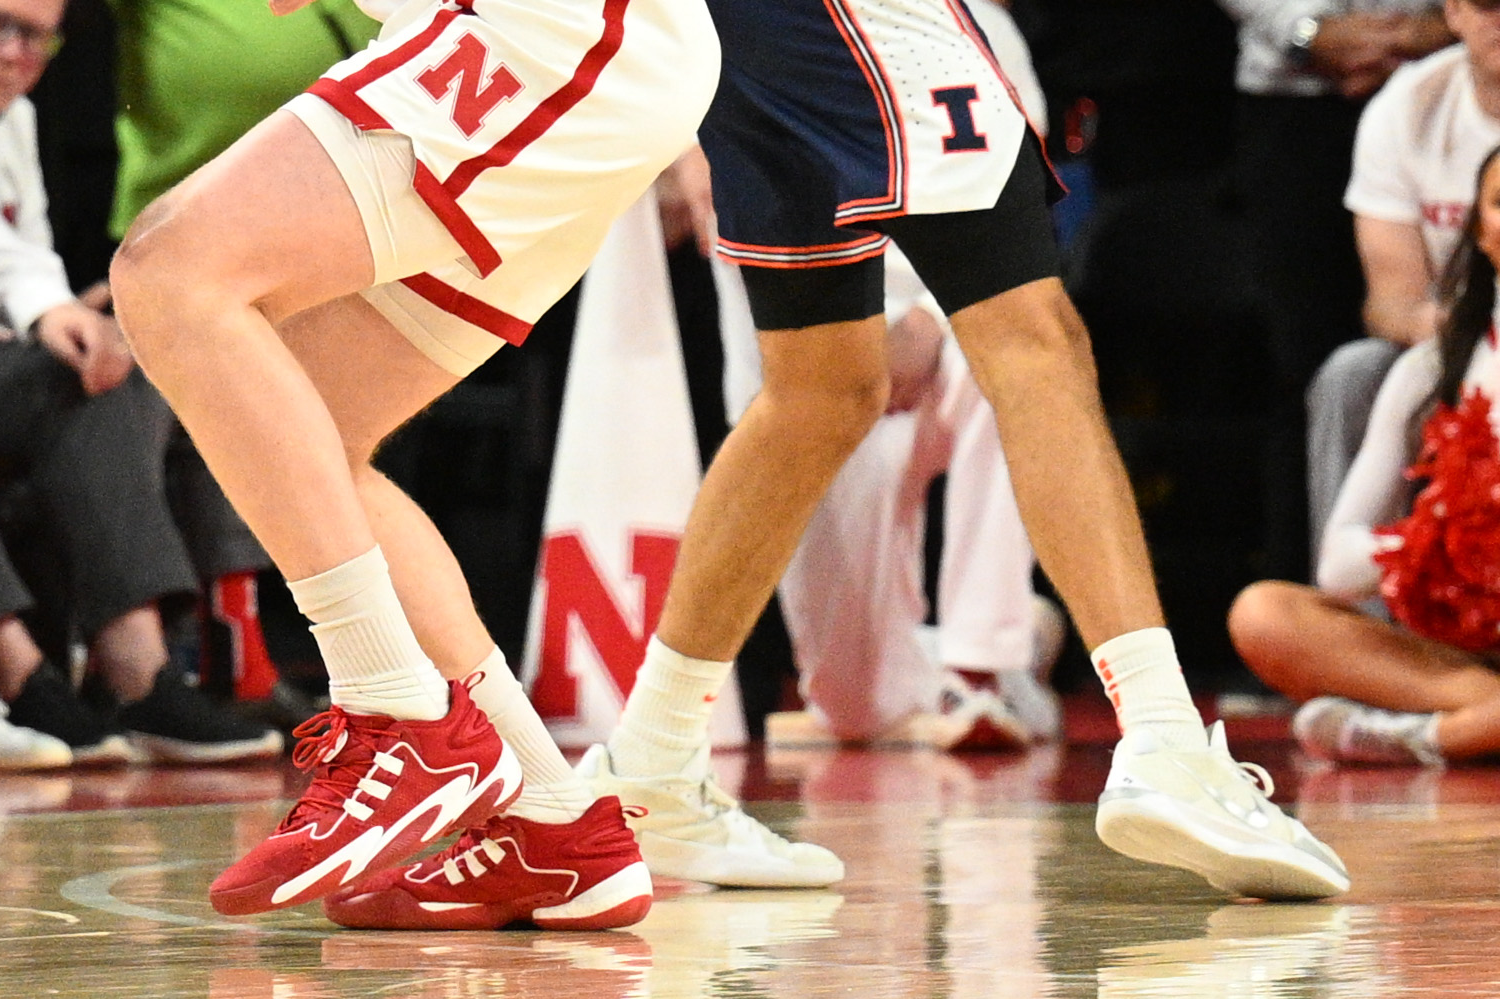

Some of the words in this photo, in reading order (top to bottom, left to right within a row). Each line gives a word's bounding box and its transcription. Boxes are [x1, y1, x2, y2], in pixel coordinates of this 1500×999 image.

[413, 29, 526, 141] N
[929, 83, 989, 154] I
[533, 528, 682, 721] N
